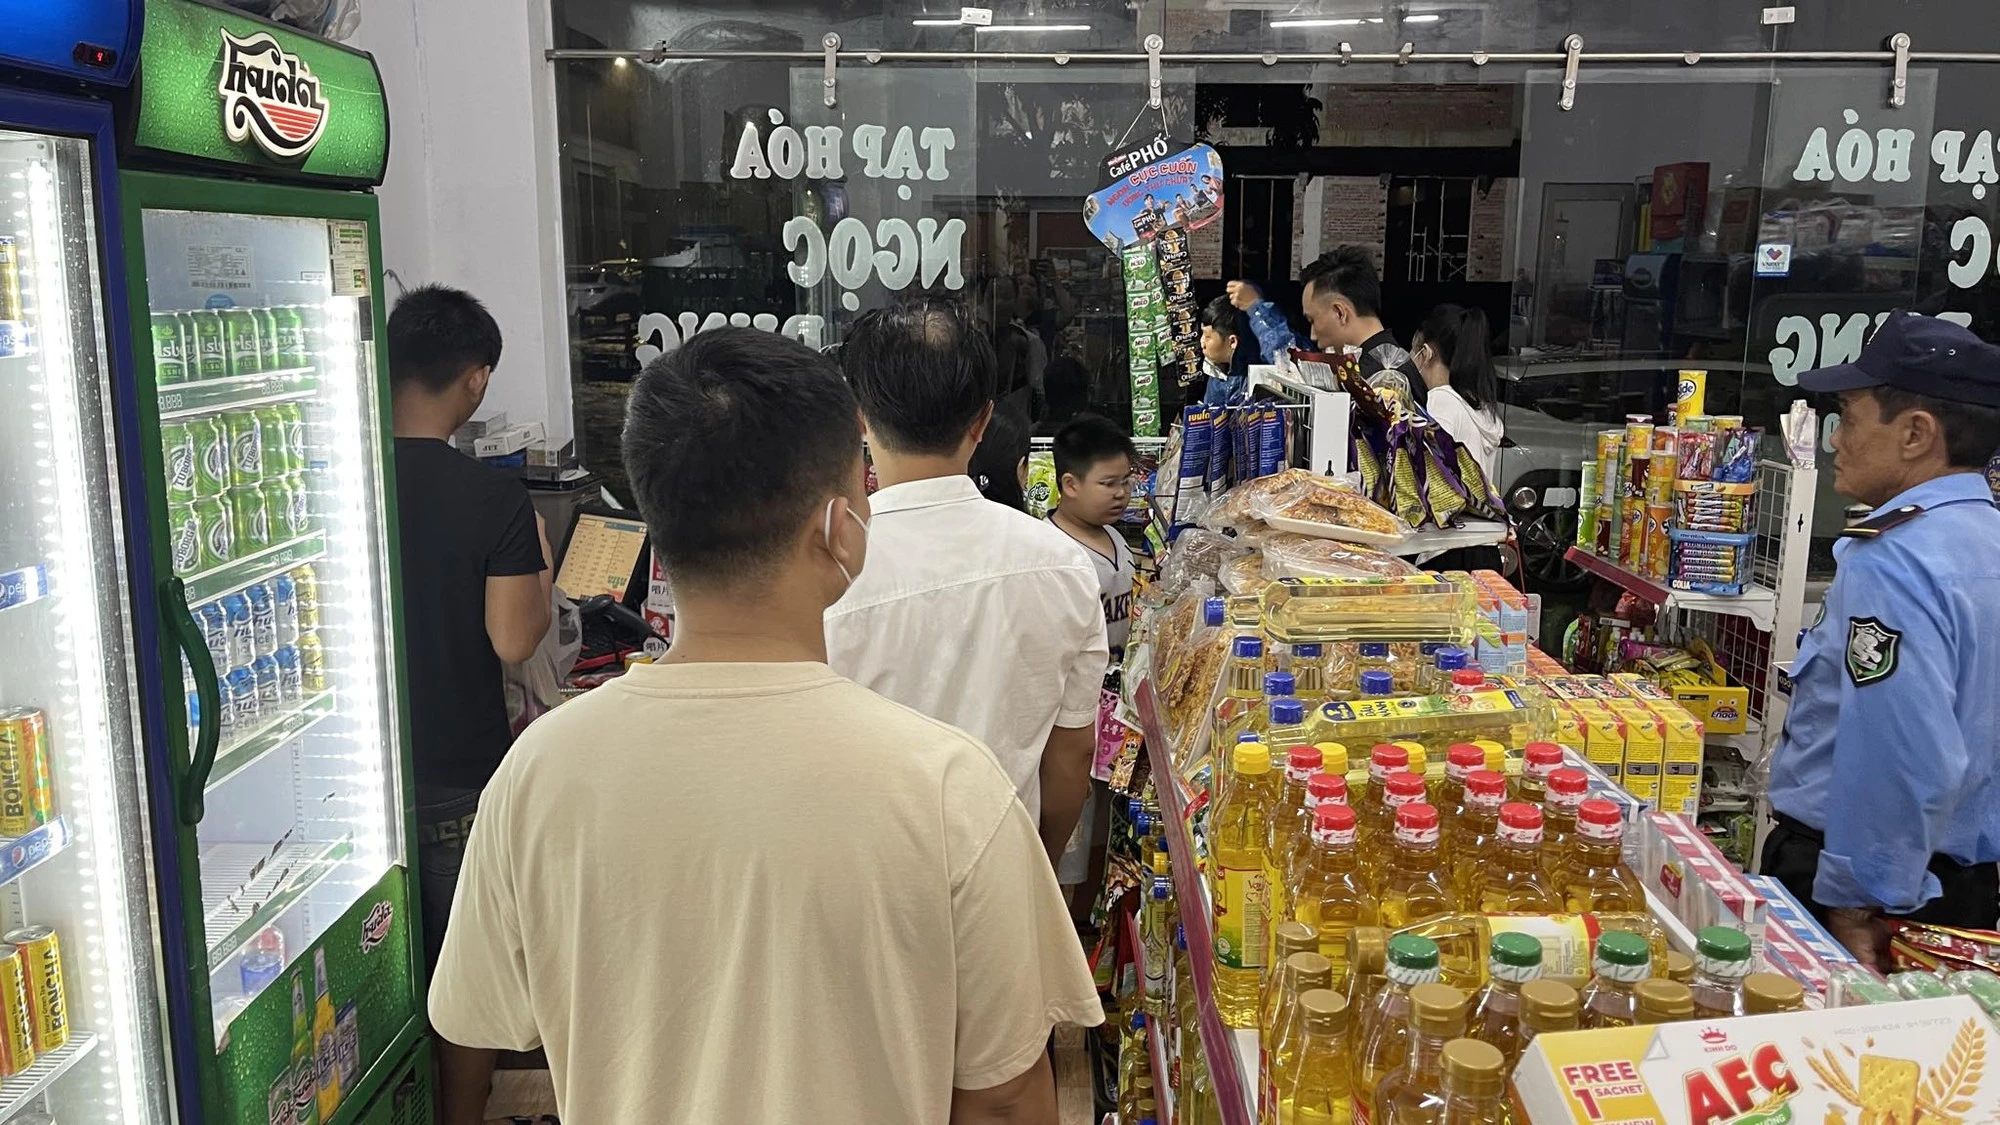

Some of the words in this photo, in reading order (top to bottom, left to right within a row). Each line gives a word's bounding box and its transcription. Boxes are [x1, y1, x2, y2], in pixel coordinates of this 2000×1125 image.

[1109, 160, 1132, 179] Café
[1127, 132, 1168, 169] PHỐ
[1671, 579, 1691, 590] GOLIA
[43, 948, 66, 1032] BONCHA
[1562, 1061, 1638, 1086] FREE
[1682, 1042, 1802, 1125] AFC
[1573, 1088, 1602, 1120] 1
[1594, 1084, 1644, 1098] SACHET
